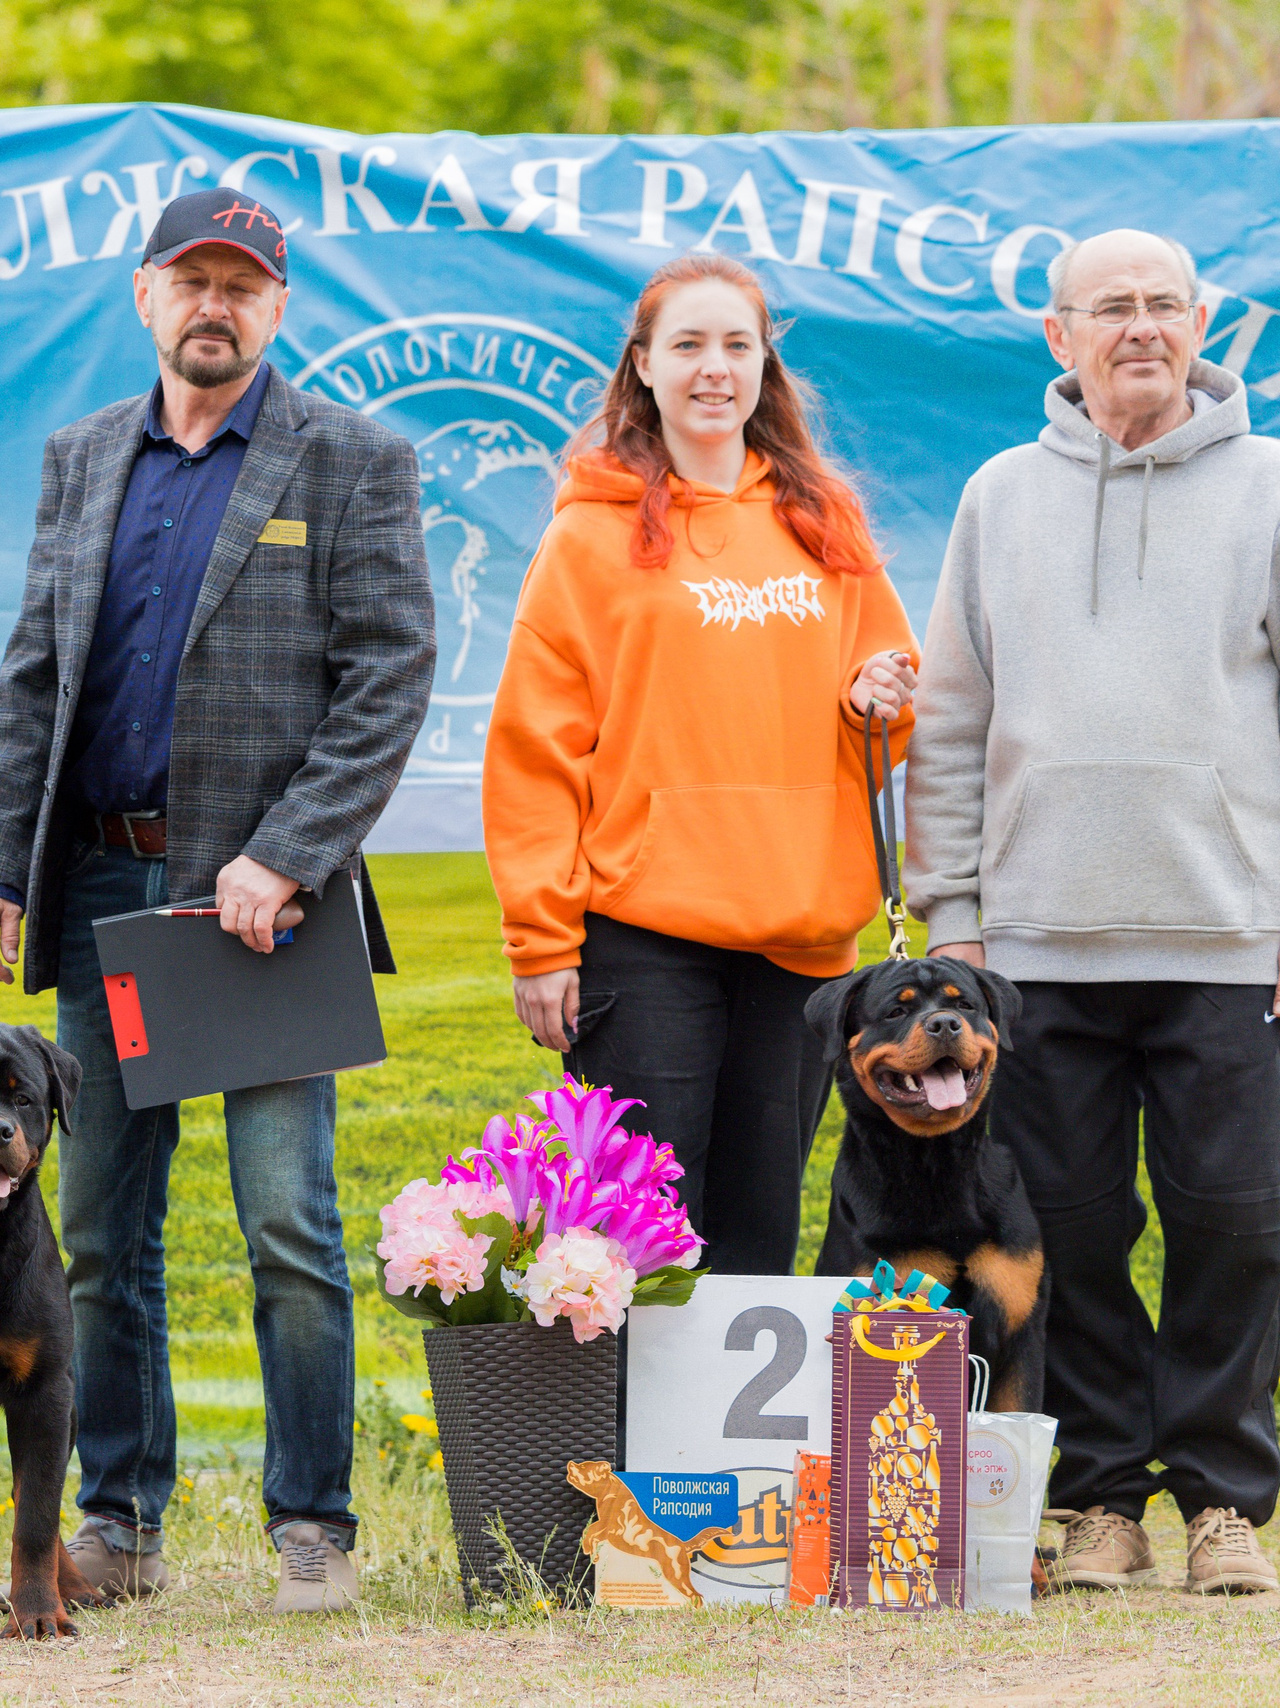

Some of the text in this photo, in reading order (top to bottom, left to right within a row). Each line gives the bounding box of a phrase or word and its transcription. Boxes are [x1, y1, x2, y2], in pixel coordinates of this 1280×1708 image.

[310, 331, 602, 415] ОЛОГИЧЕС
[722, 1305, 809, 1441] 2
[653, 1476, 730, 1495] Поволжская
[653, 1497, 712, 1518] Рапсодия
